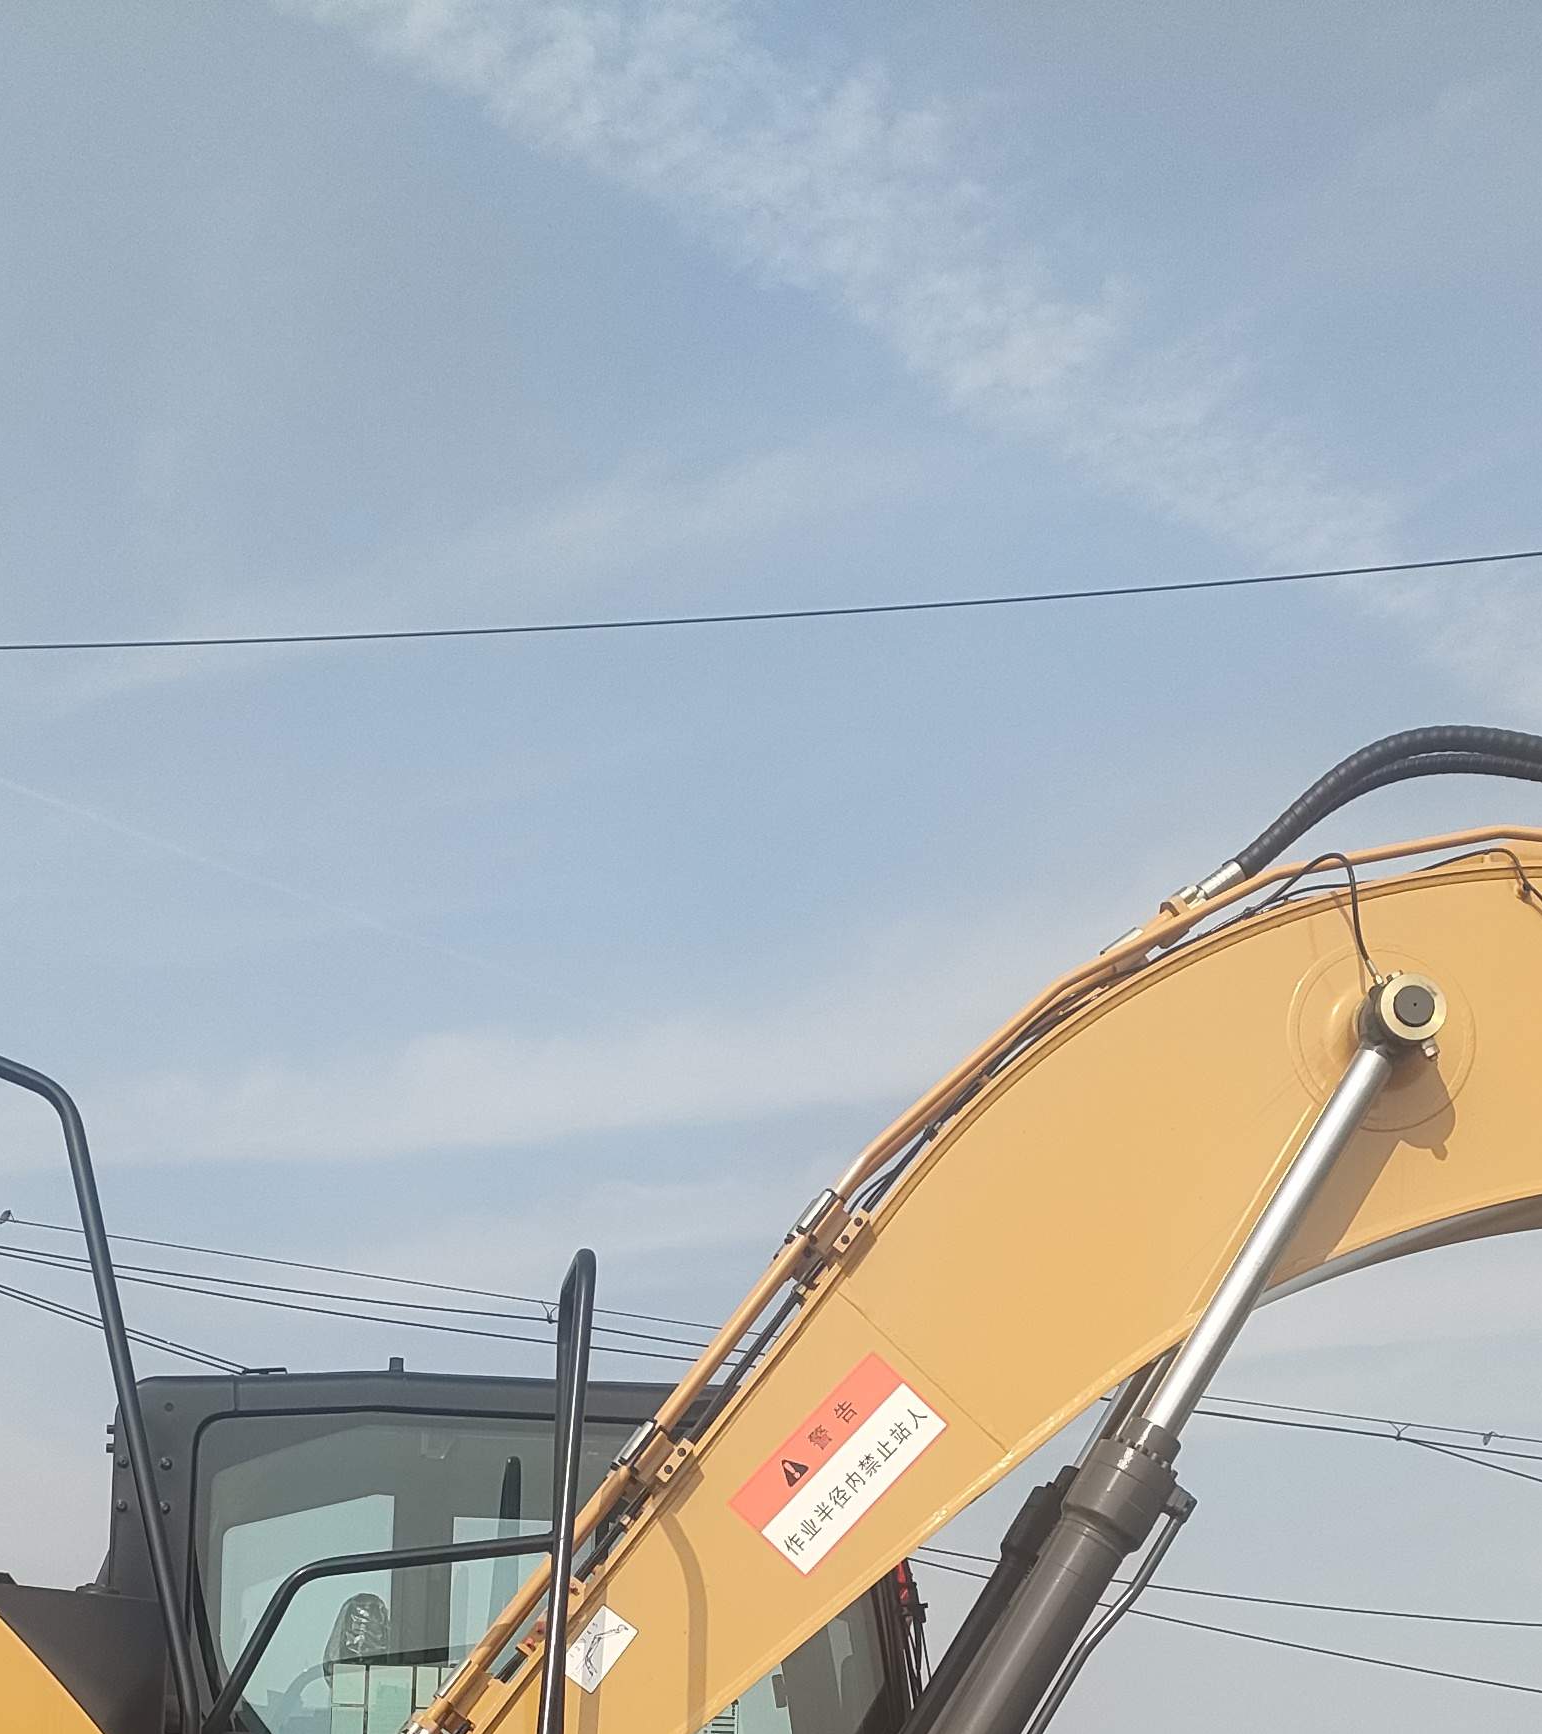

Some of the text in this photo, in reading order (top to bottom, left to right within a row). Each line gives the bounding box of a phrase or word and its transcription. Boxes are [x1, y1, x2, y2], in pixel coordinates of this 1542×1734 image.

[807, 1400, 858, 1450] 警告
[782, 1407, 929, 1556] 作业半径内禁止站人
